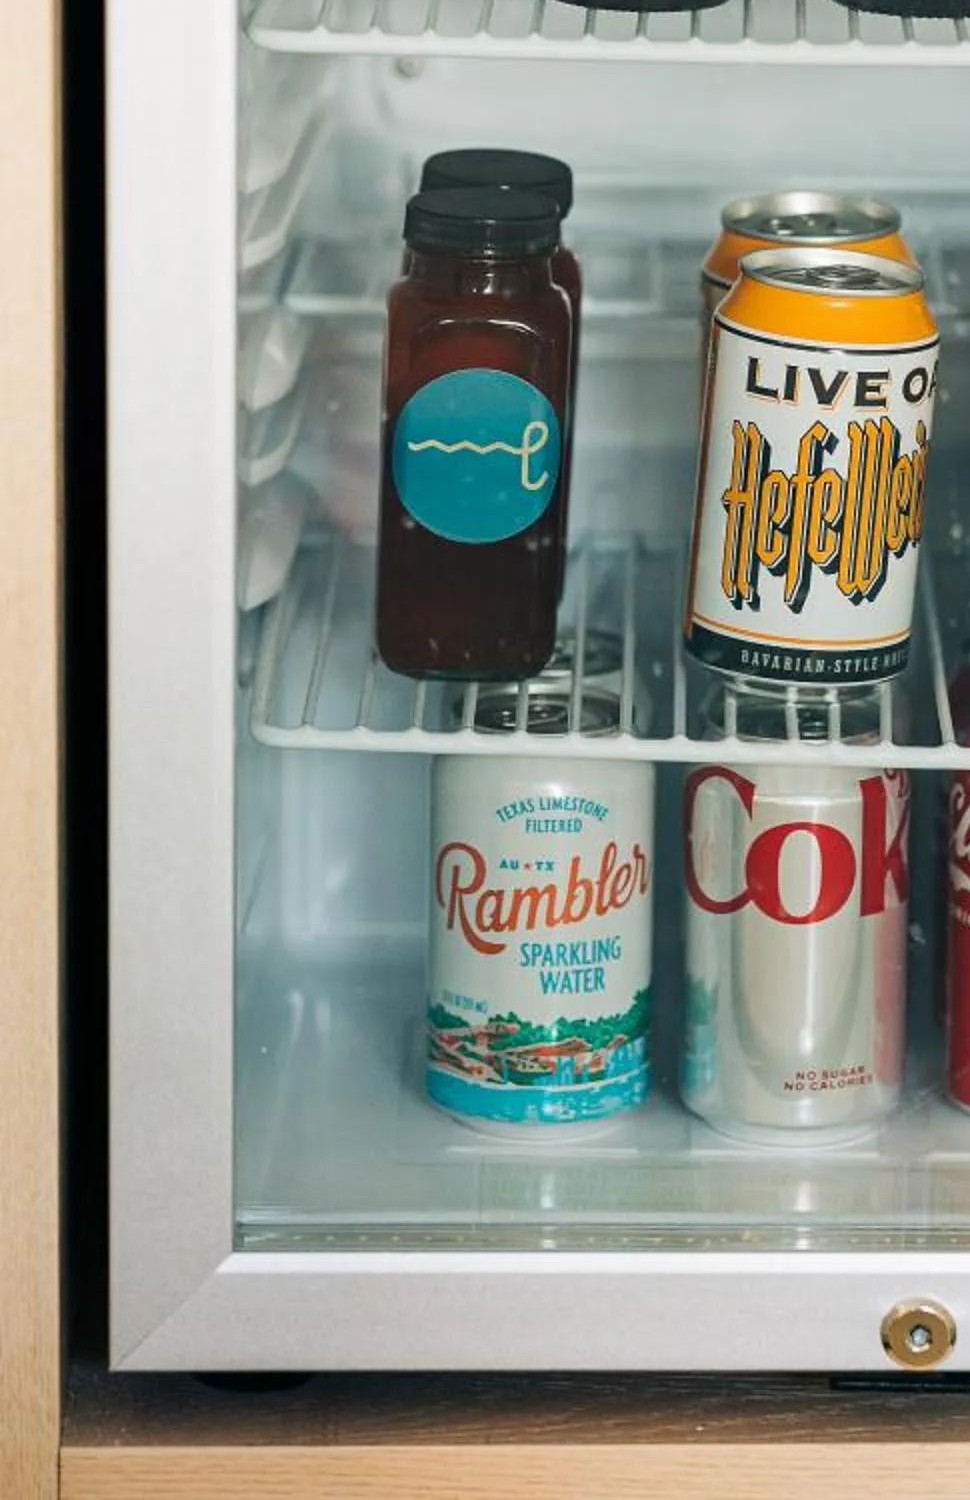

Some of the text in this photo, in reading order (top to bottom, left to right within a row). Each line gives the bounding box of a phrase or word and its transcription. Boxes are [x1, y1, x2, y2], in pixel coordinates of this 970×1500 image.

[745, 355, 890, 409] LIVE
[496, 796, 609, 823] TEXAS LIMESTONE
[525, 818, 583, 833] FILTERED
[499, 859, 555, 871] AU TX
[436, 841, 648, 955] Rambler
[520, 936, 622, 967] SPARKLING
[540, 967, 606, 994] WATER
[784, 1081, 804, 1091] NO
[796, 1071, 817, 1081] NO
